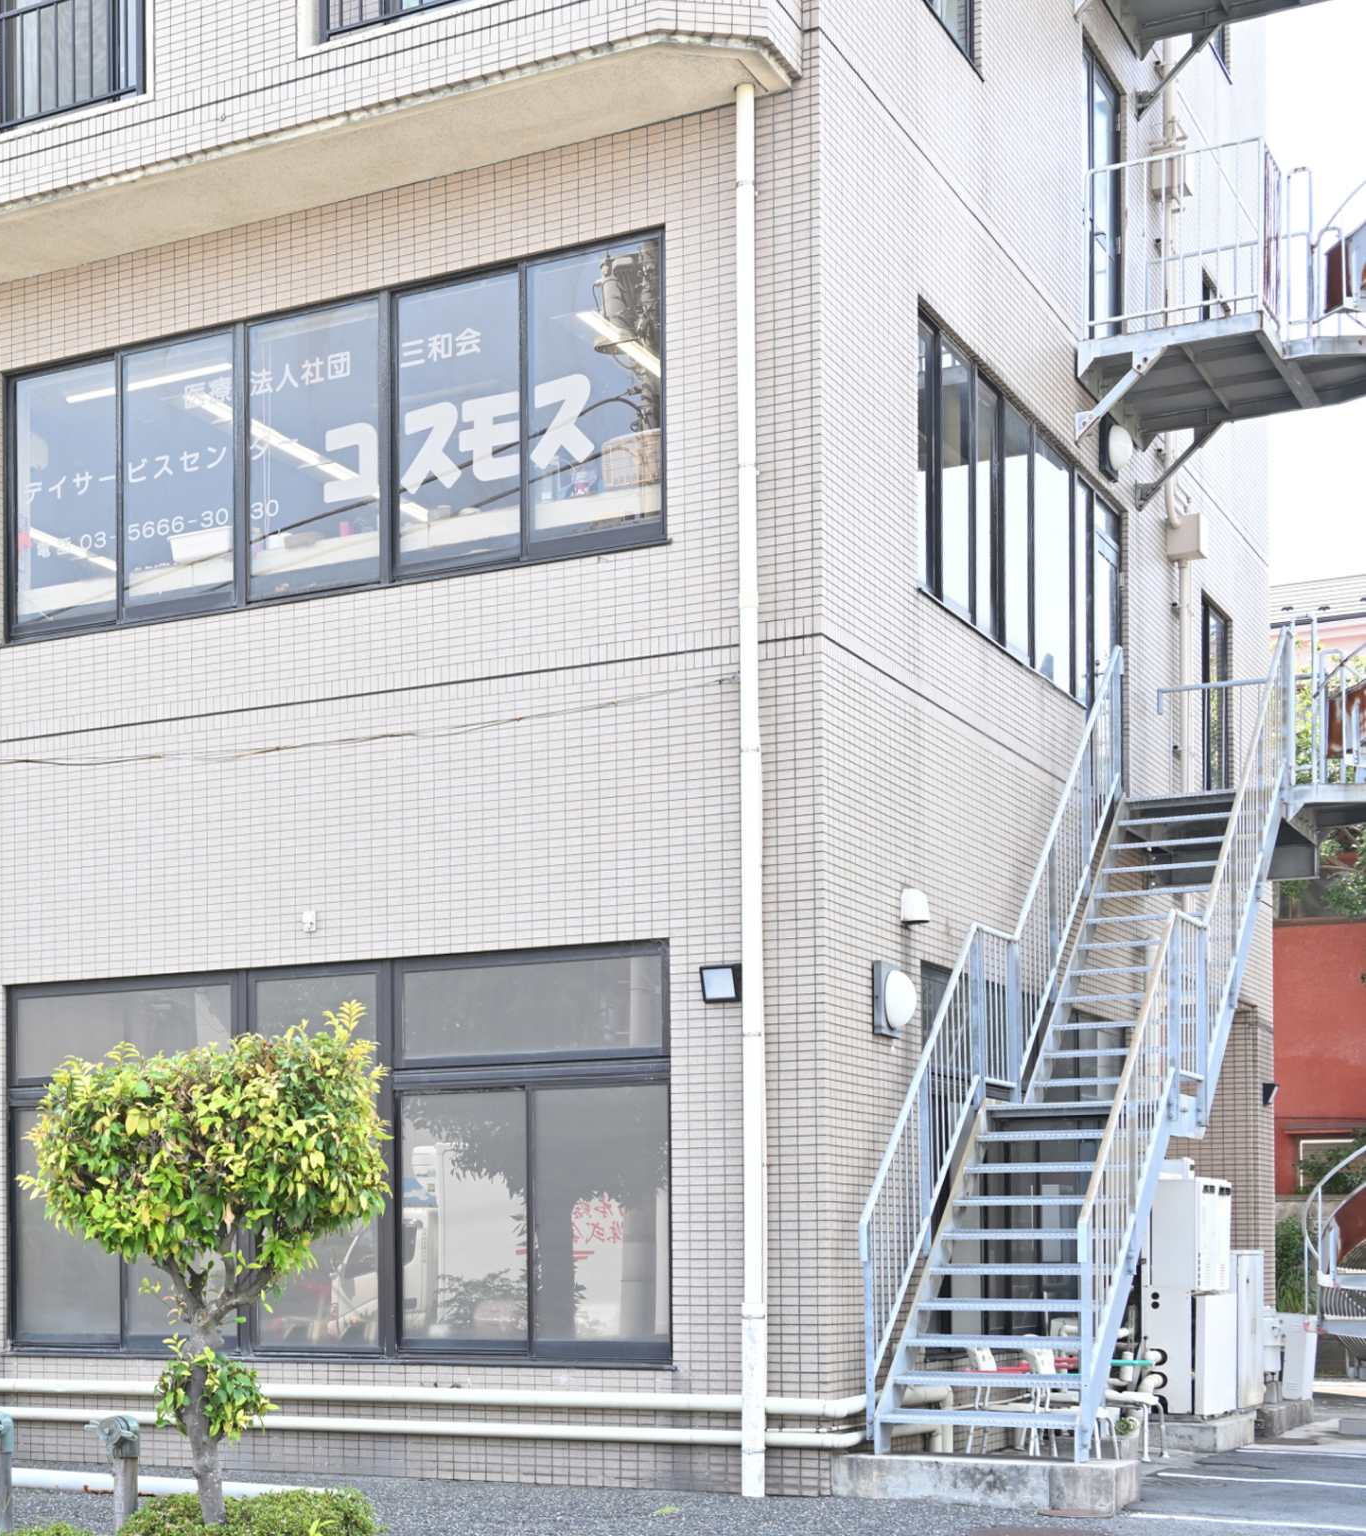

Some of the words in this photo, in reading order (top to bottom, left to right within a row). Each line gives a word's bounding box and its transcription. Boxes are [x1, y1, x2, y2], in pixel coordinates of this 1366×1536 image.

[184, 351, 350, 409] 医療法人社団
[400, 327, 482, 368] 三和会
[23, 434, 299, 505] デイサービスセンター
[323, 373, 595, 503] コスモス
[80, 499, 280, 551] 03-5666-3030
